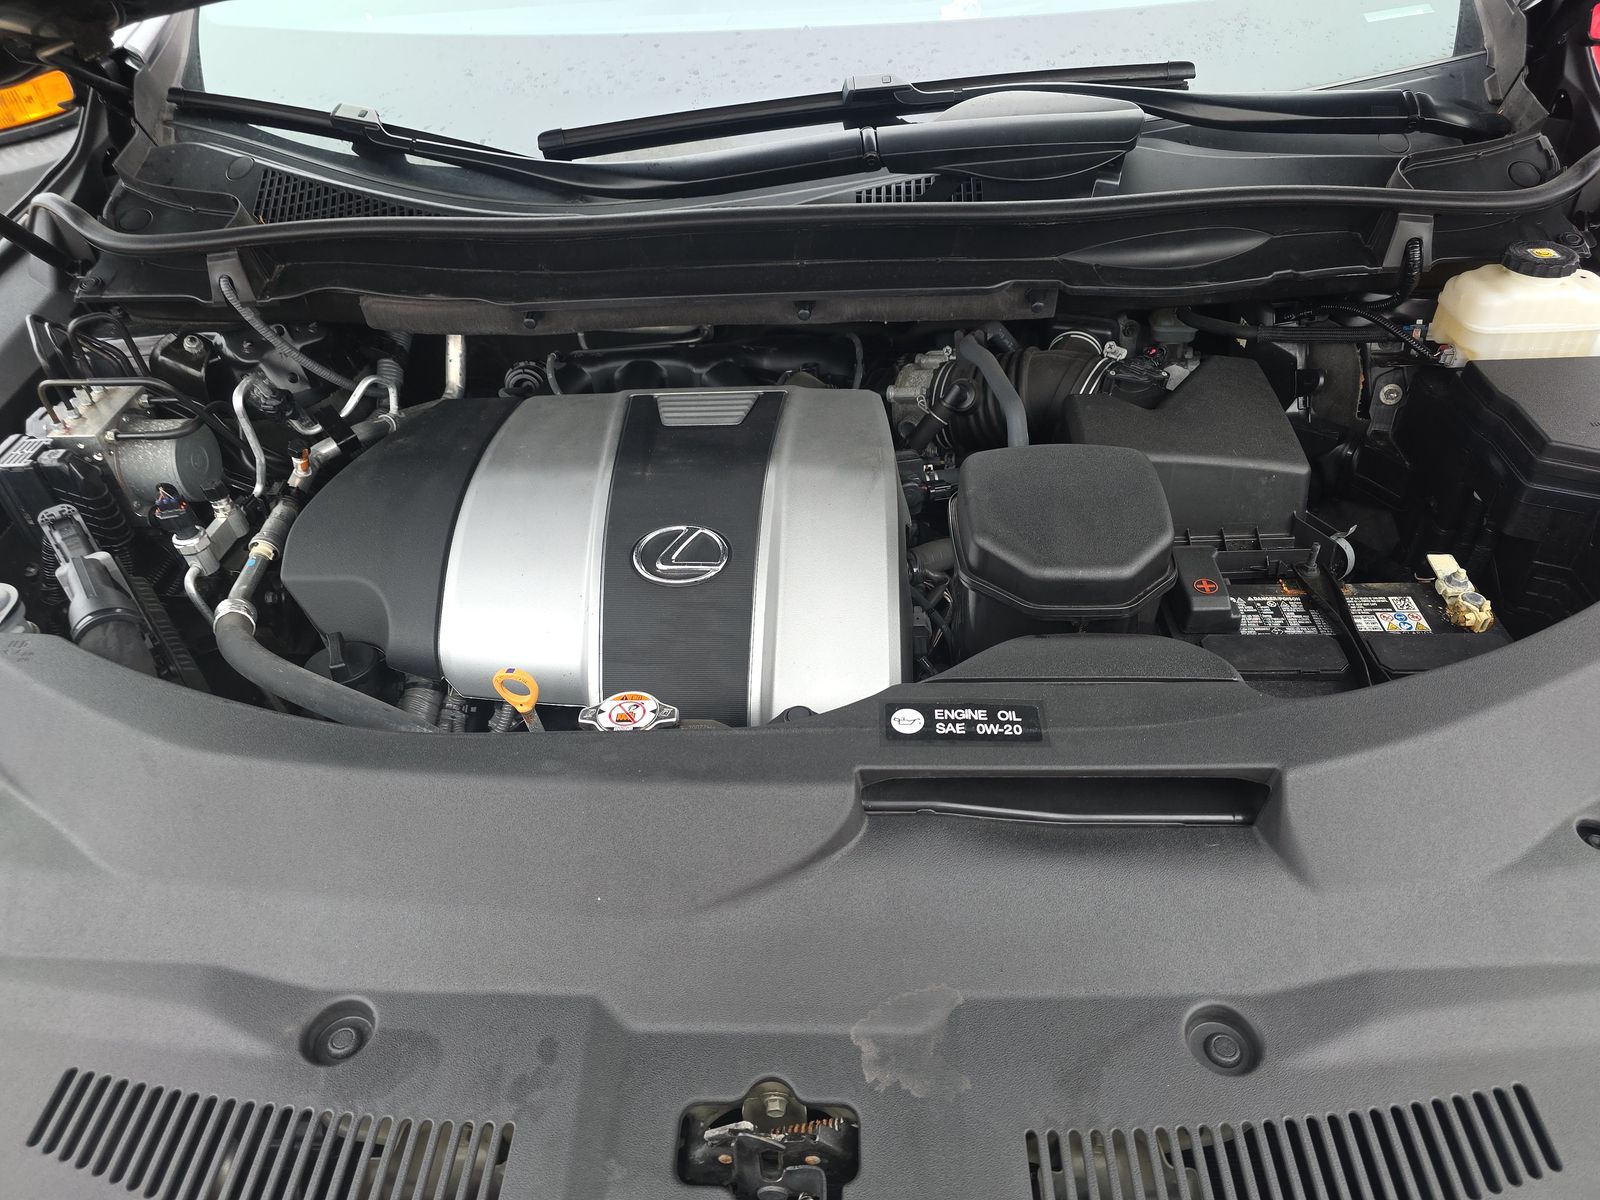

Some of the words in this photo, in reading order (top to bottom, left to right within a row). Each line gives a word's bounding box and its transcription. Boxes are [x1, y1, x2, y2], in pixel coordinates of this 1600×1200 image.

[934, 709, 988, 721] ENGINE
[997, 710, 1022, 722] OIL
[935, 722, 966, 735] SAE
[976, 723, 1023, 736] 0W-20
